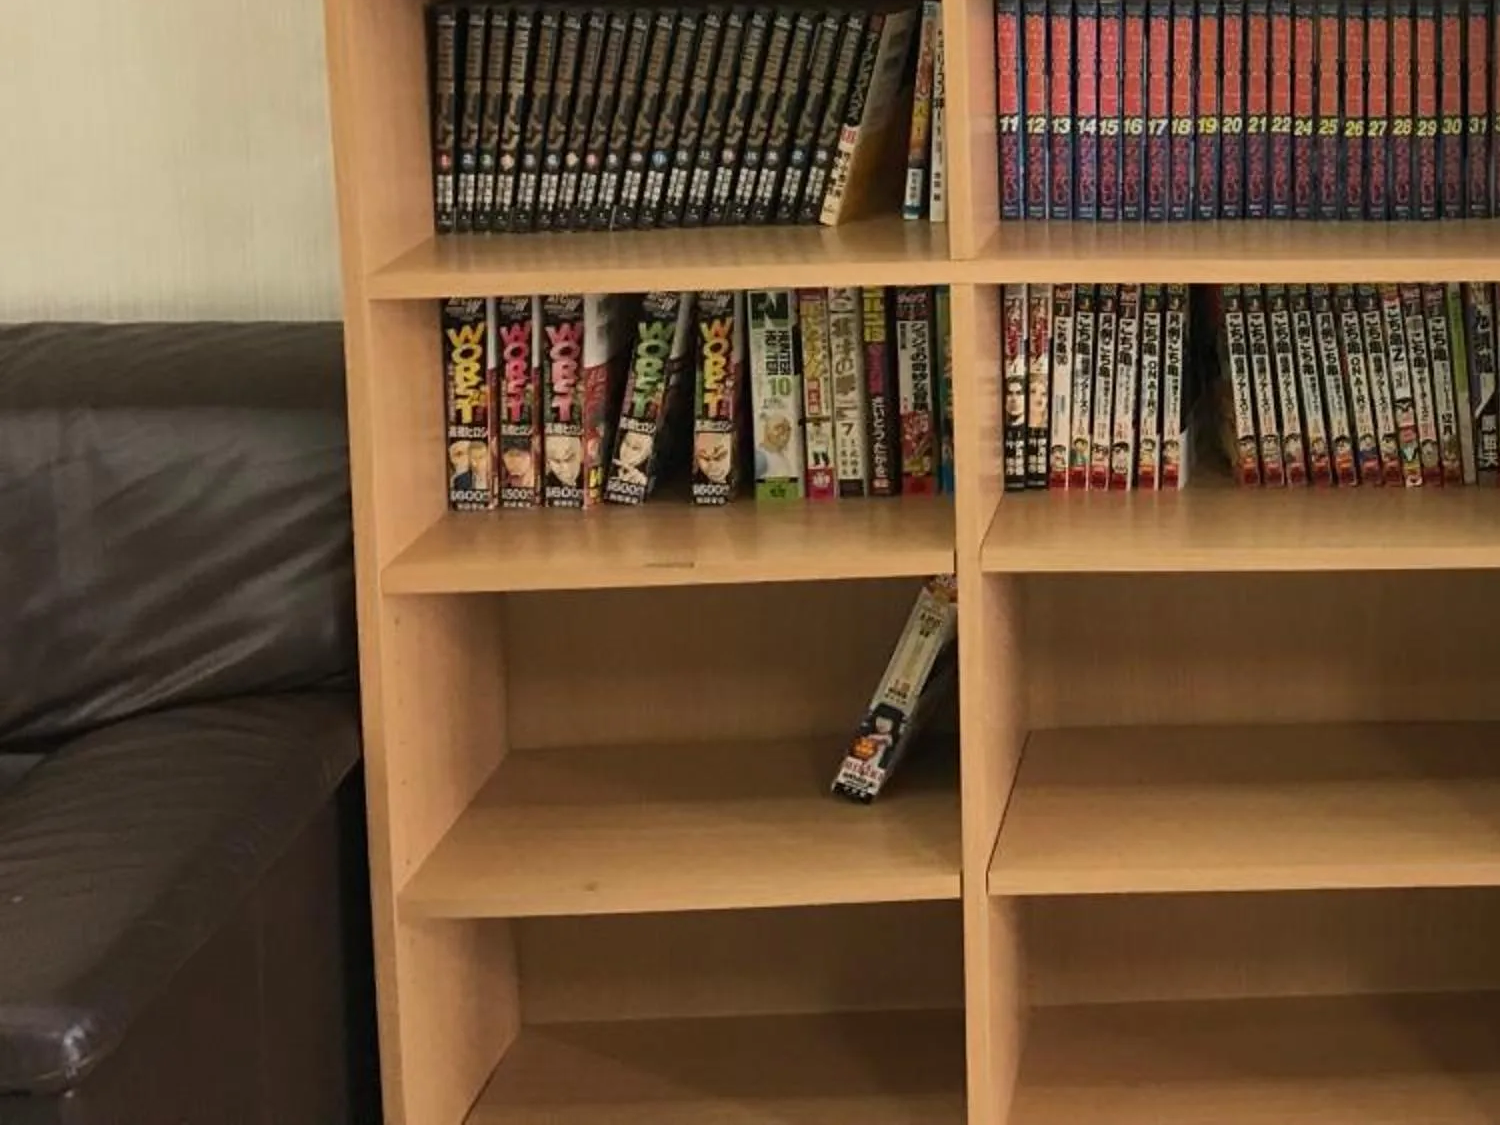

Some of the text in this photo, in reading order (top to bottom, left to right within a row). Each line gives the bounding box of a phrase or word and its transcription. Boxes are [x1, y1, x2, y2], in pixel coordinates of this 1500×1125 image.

[1000, 117, 1019, 132] 11
[1027, 118, 1045, 133] 12
[1052, 118, 1070, 134] 13
[1078, 118, 1097, 134] 14
[1100, 119, 1119, 135] 15
[1124, 118, 1143, 134] 16
[1149, 119, 1168, 135] 17
[1171, 119, 1190, 134] 18
[1199, 118, 1218, 134] 19
[1222, 118, 1242, 133] 20
[1248, 117, 1267, 132] 21
[1272, 117, 1292, 133] 22
[1294, 119, 1313, 135] 24
[1319, 118, 1338, 134] 25
[1345, 120, 1364, 136] 26
[1368, 120, 1387, 136] 27
[1393, 119, 1412, 135] 28
[1418, 120, 1437, 136] 29
[1443, 118, 1462, 134] 30
[1469, 118, 1487, 133] 31
[448, 323, 486, 423] WORST
[500, 323, 531, 421] WORST
[546, 322, 583, 421] WORST
[633, 321, 674, 418] WORST
[701, 317, 733, 416] WORST
[767, 379, 792, 396] 10
